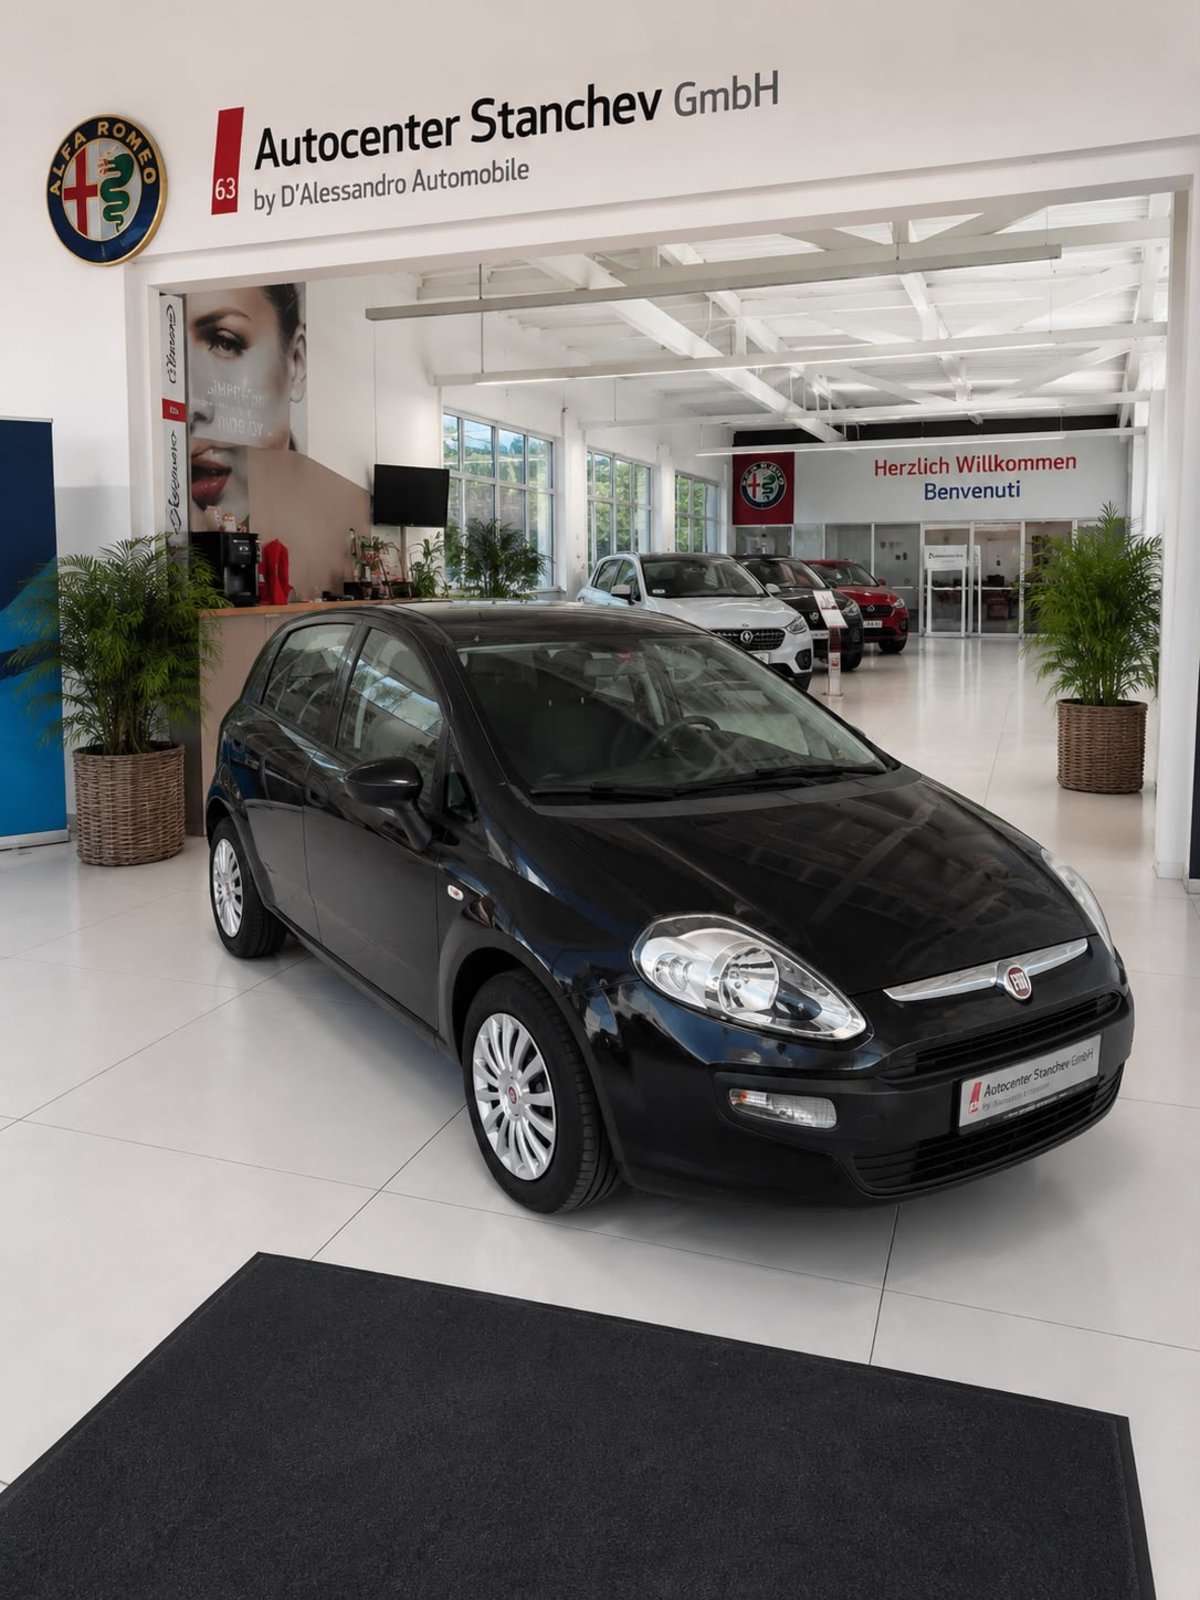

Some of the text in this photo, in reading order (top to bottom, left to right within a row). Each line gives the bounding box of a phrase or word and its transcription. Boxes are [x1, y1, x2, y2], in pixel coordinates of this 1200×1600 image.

[254, 70, 779, 170] Autocenter Stanchev GmbH
[49, 120, 157, 196] ALFA ROMEO
[214, 177, 237, 201] 63
[253, 157, 530, 216] by D'Alessandro Automobile
[874, 453, 1077, 477] Herzlich Willkommen
[924, 480, 1021, 500] Benvenuti
[983, 1072, 1033, 1098] Autocenter
[1033, 1060, 1069, 1081] Stanchev
